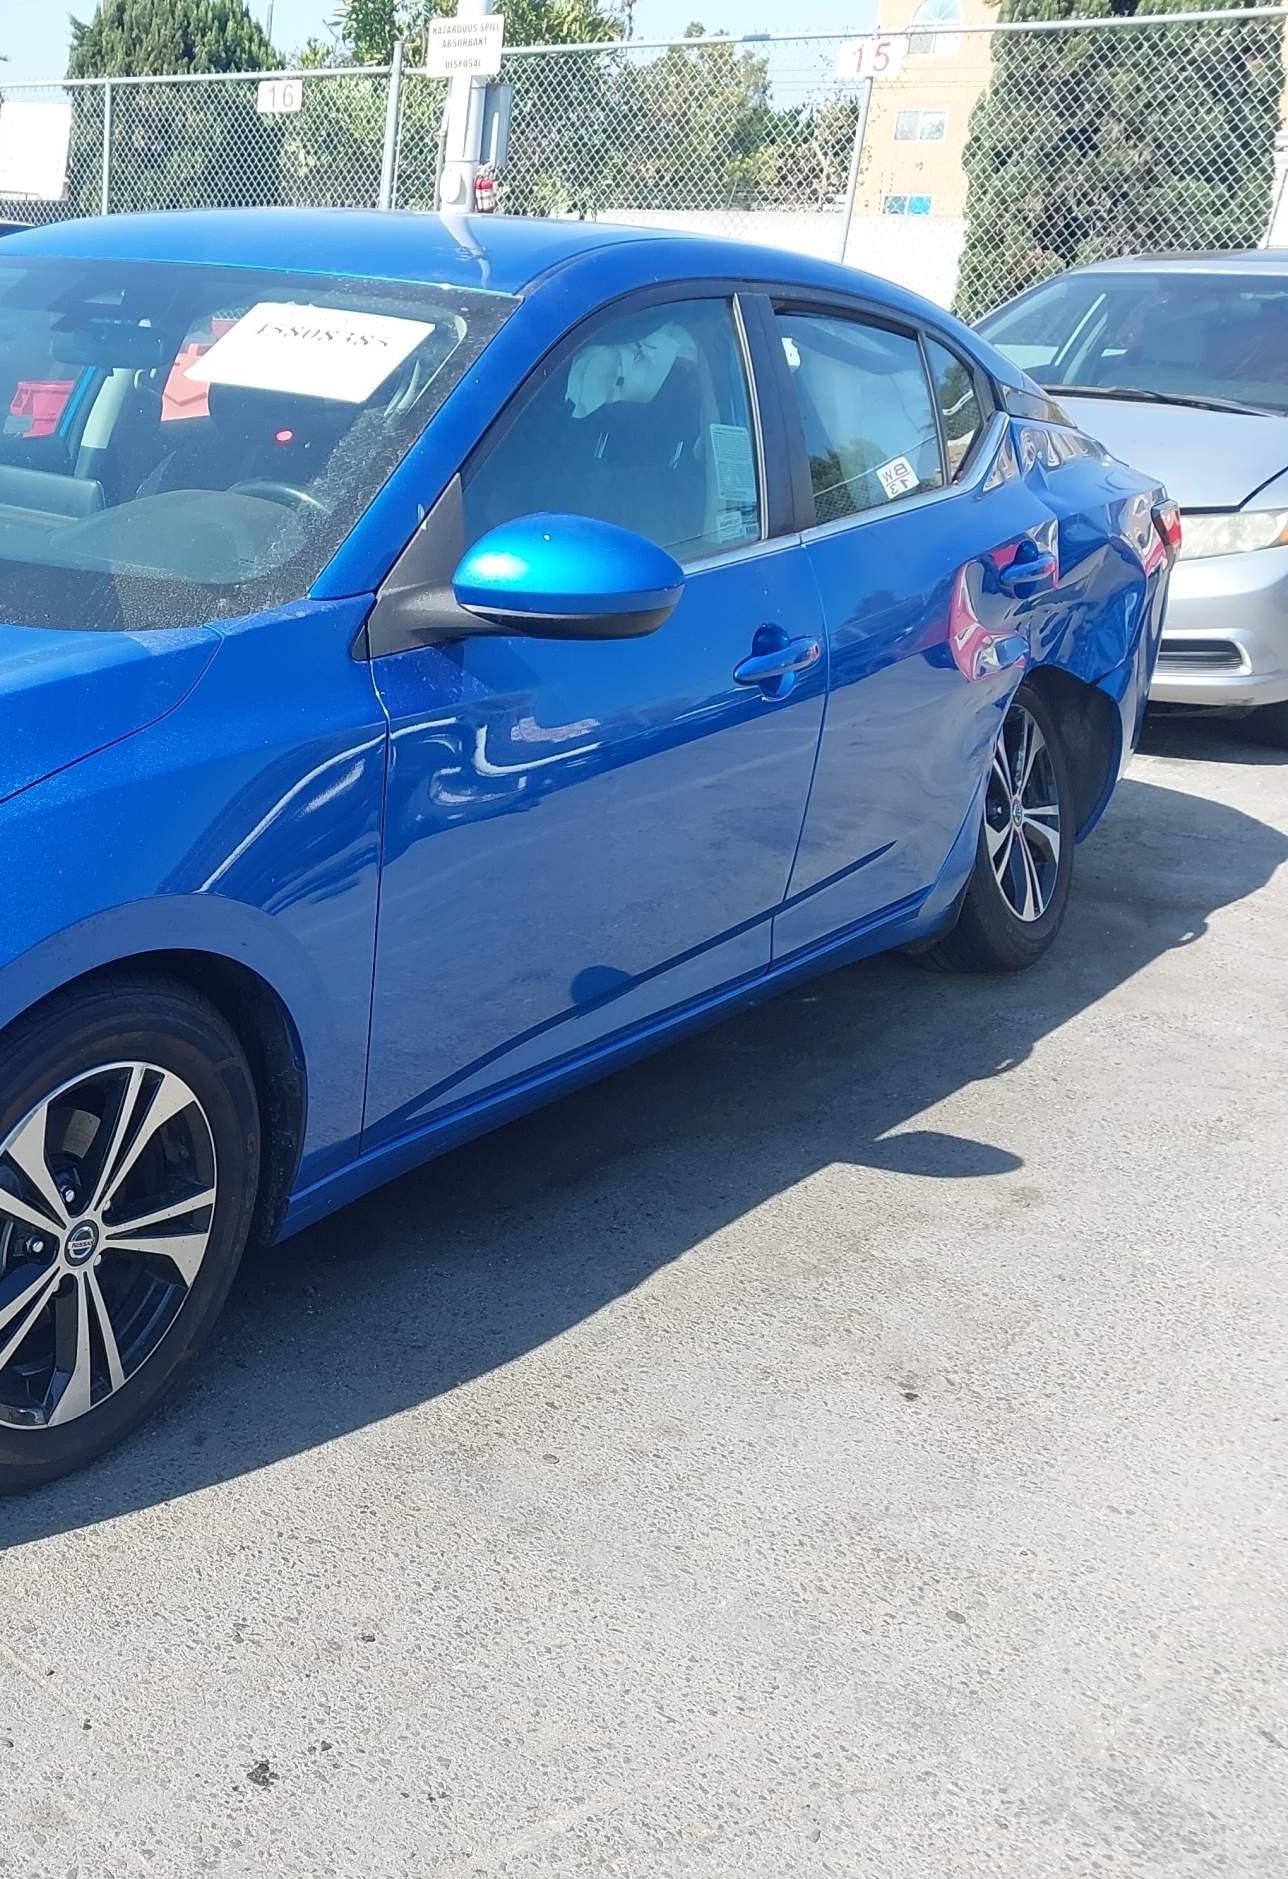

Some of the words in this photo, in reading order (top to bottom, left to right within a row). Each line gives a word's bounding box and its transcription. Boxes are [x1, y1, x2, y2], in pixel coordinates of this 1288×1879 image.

[432, 24, 478, 35] HAZARDOUS
[445, 58, 481, 69] DISPOSAL
[853, 42, 890, 73] 15
[268, 84, 294, 108] 16
